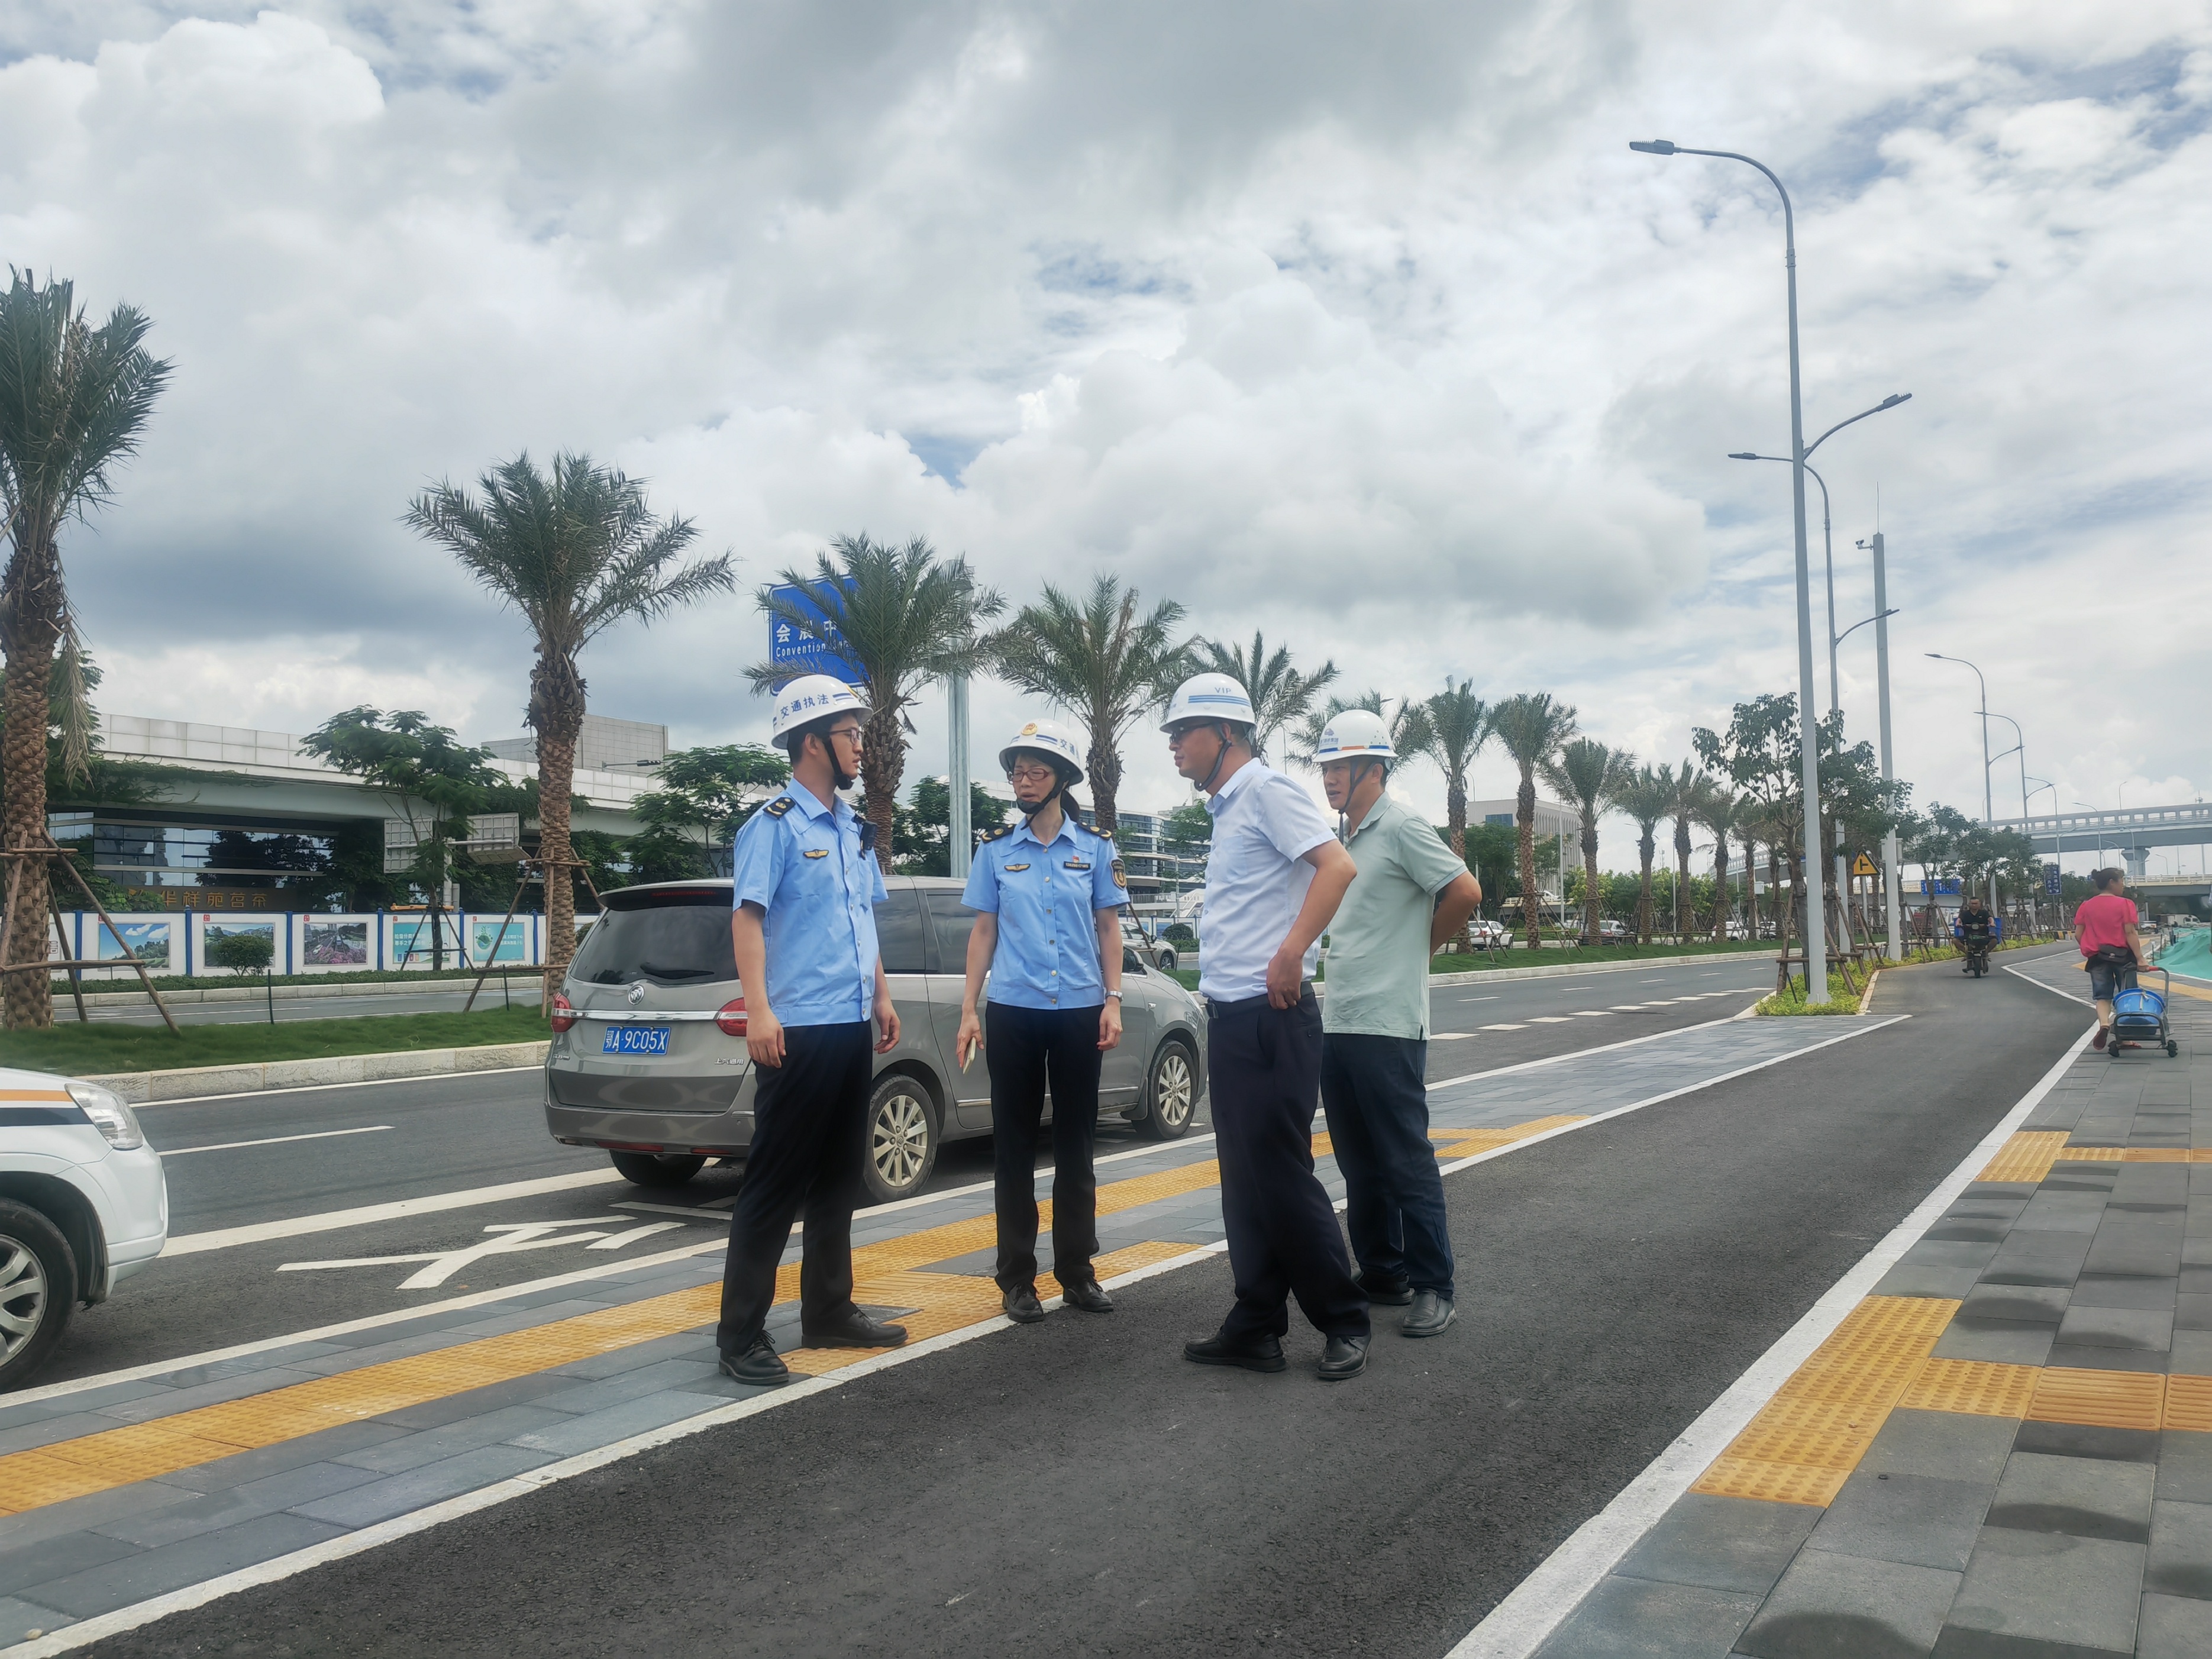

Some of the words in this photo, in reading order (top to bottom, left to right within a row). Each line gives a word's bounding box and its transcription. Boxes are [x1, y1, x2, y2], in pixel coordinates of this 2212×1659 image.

[776, 620, 837, 643] 会展中
[776, 643, 826, 657] Convention
[780, 693, 829, 719] 交通执法
[1060, 738, 1077, 757] 交通
[161, 890, 267, 908] 华祥苑茗茶
